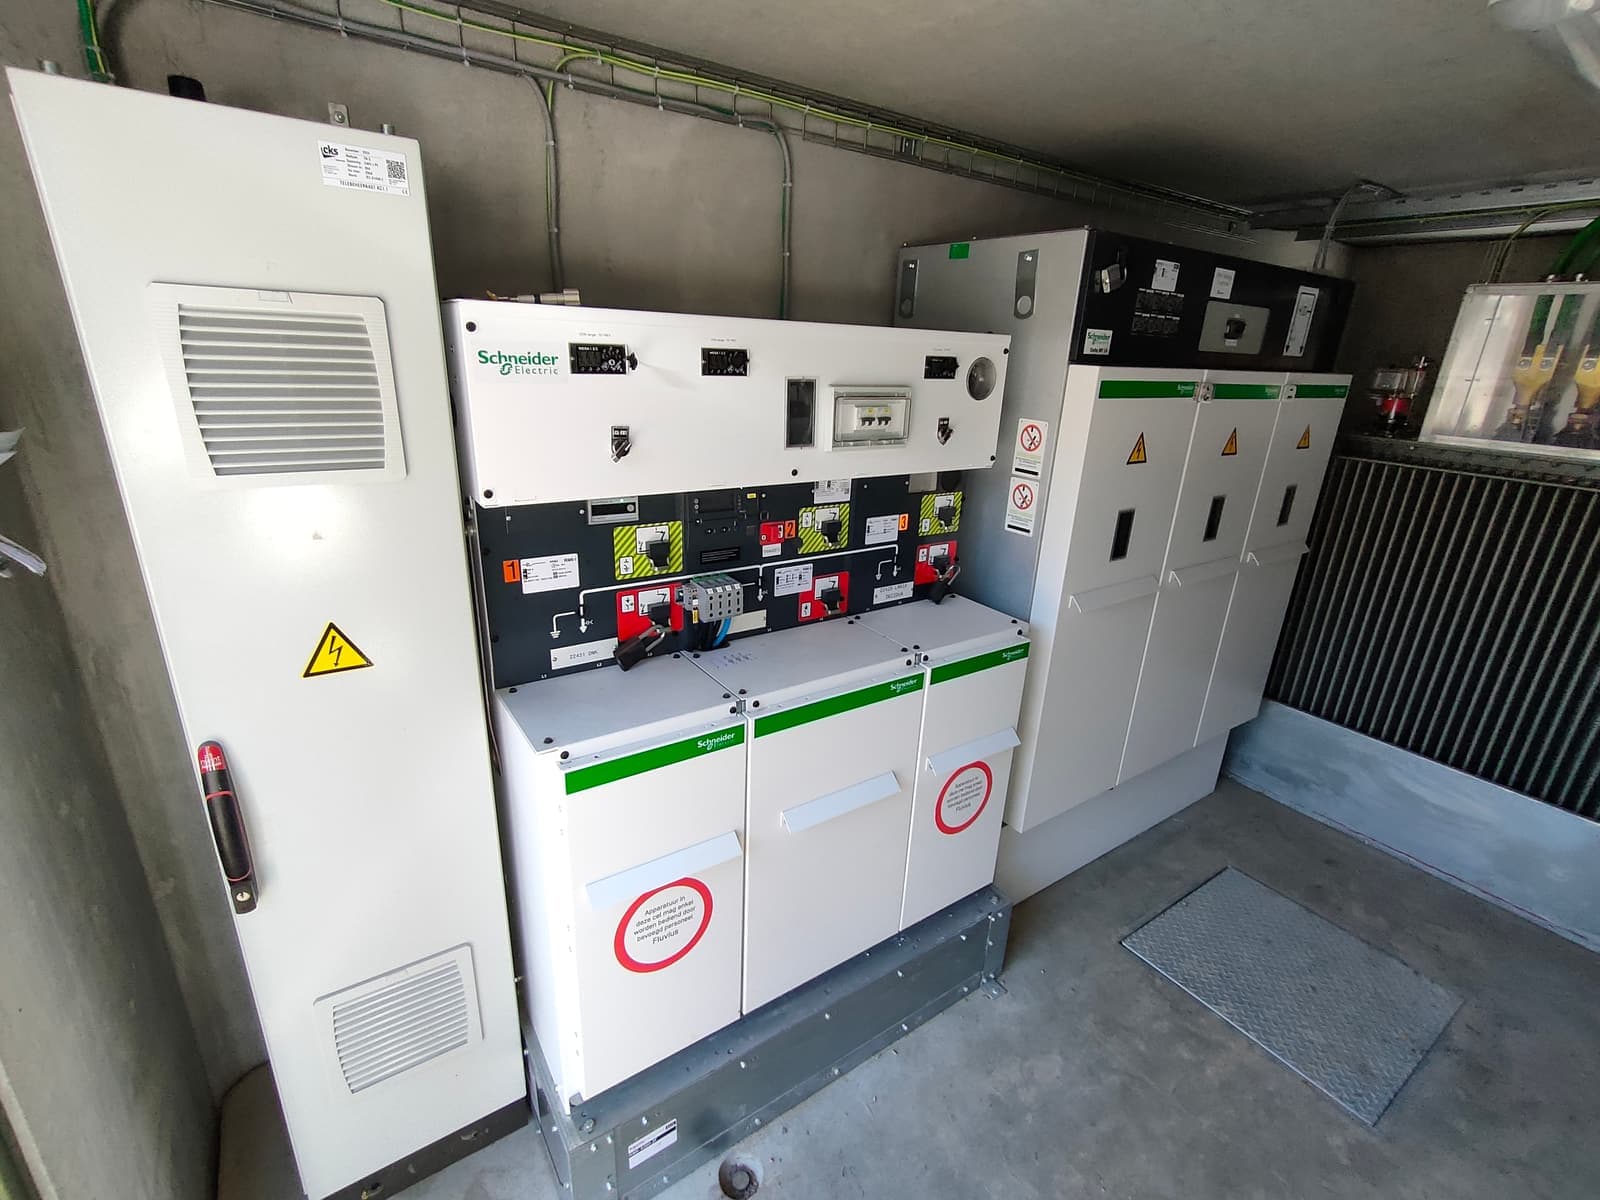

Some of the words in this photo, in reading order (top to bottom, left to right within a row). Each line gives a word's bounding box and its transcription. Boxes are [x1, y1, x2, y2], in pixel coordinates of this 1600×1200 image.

[322, 145, 339, 156] cks
[478, 350, 559, 365] Schneider
[515, 365, 559, 375] Electric
[787, 522, 794, 537] 2
[901, 515, 907, 529] 3
[507, 561, 516, 580] 1
[890, 679, 918, 690] Schneider
[697, 733, 735, 748] Schneider
[635, 918, 651, 927] deze
[652, 912, 662, 921] cel
[662, 906, 677, 917] mag
[677, 900, 694, 910] enkel
[645, 898, 679, 916] Apparatuur
[633, 923, 657, 936] worden
[657, 912, 682, 926] bediend
[682, 906, 696, 916] door
[636, 927, 664, 942] bevoegd
[663, 914, 694, 932] personeel
[652, 929, 679, 944] Fluvius
